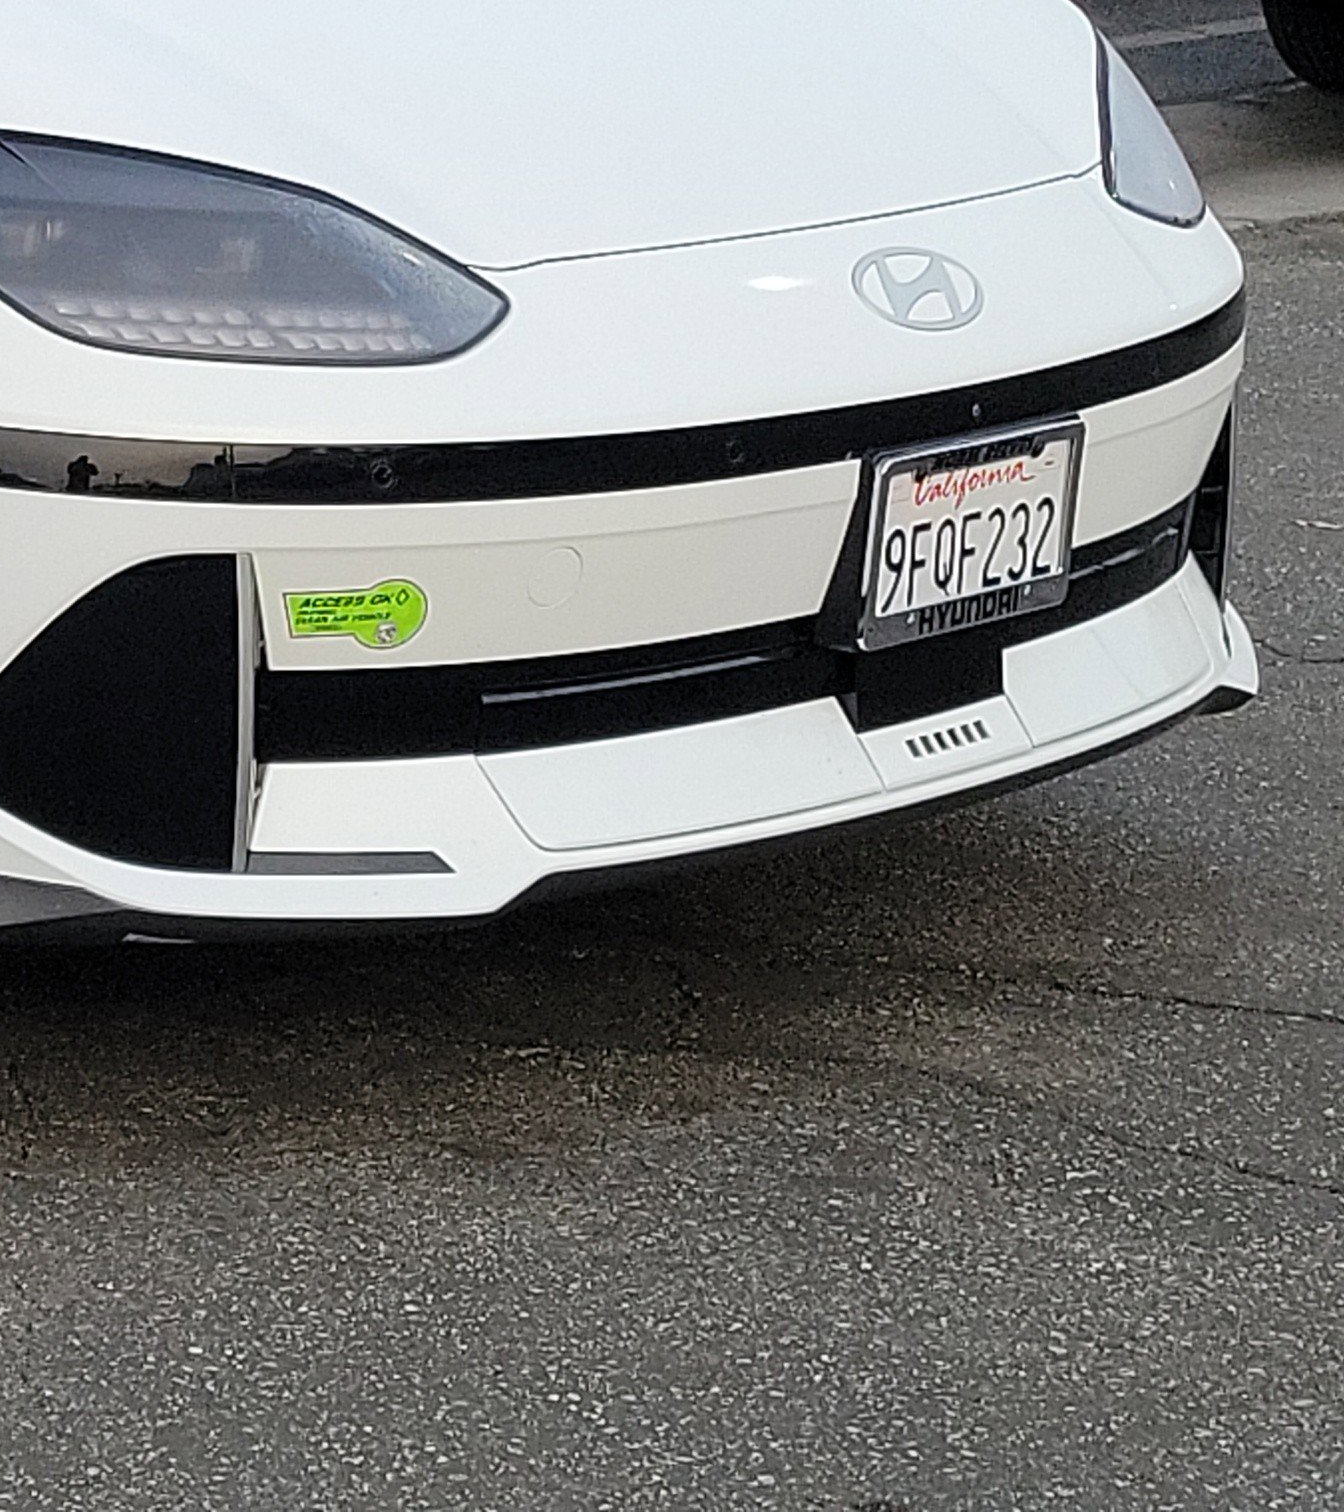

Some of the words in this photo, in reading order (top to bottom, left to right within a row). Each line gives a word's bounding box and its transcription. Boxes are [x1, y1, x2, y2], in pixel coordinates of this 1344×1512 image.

[914, 460, 1036, 509] California
[880, 496, 1056, 614] 9FQF232
[299, 595, 366, 609] ACCESS
[918, 586, 1020, 635] HYUNDAI
